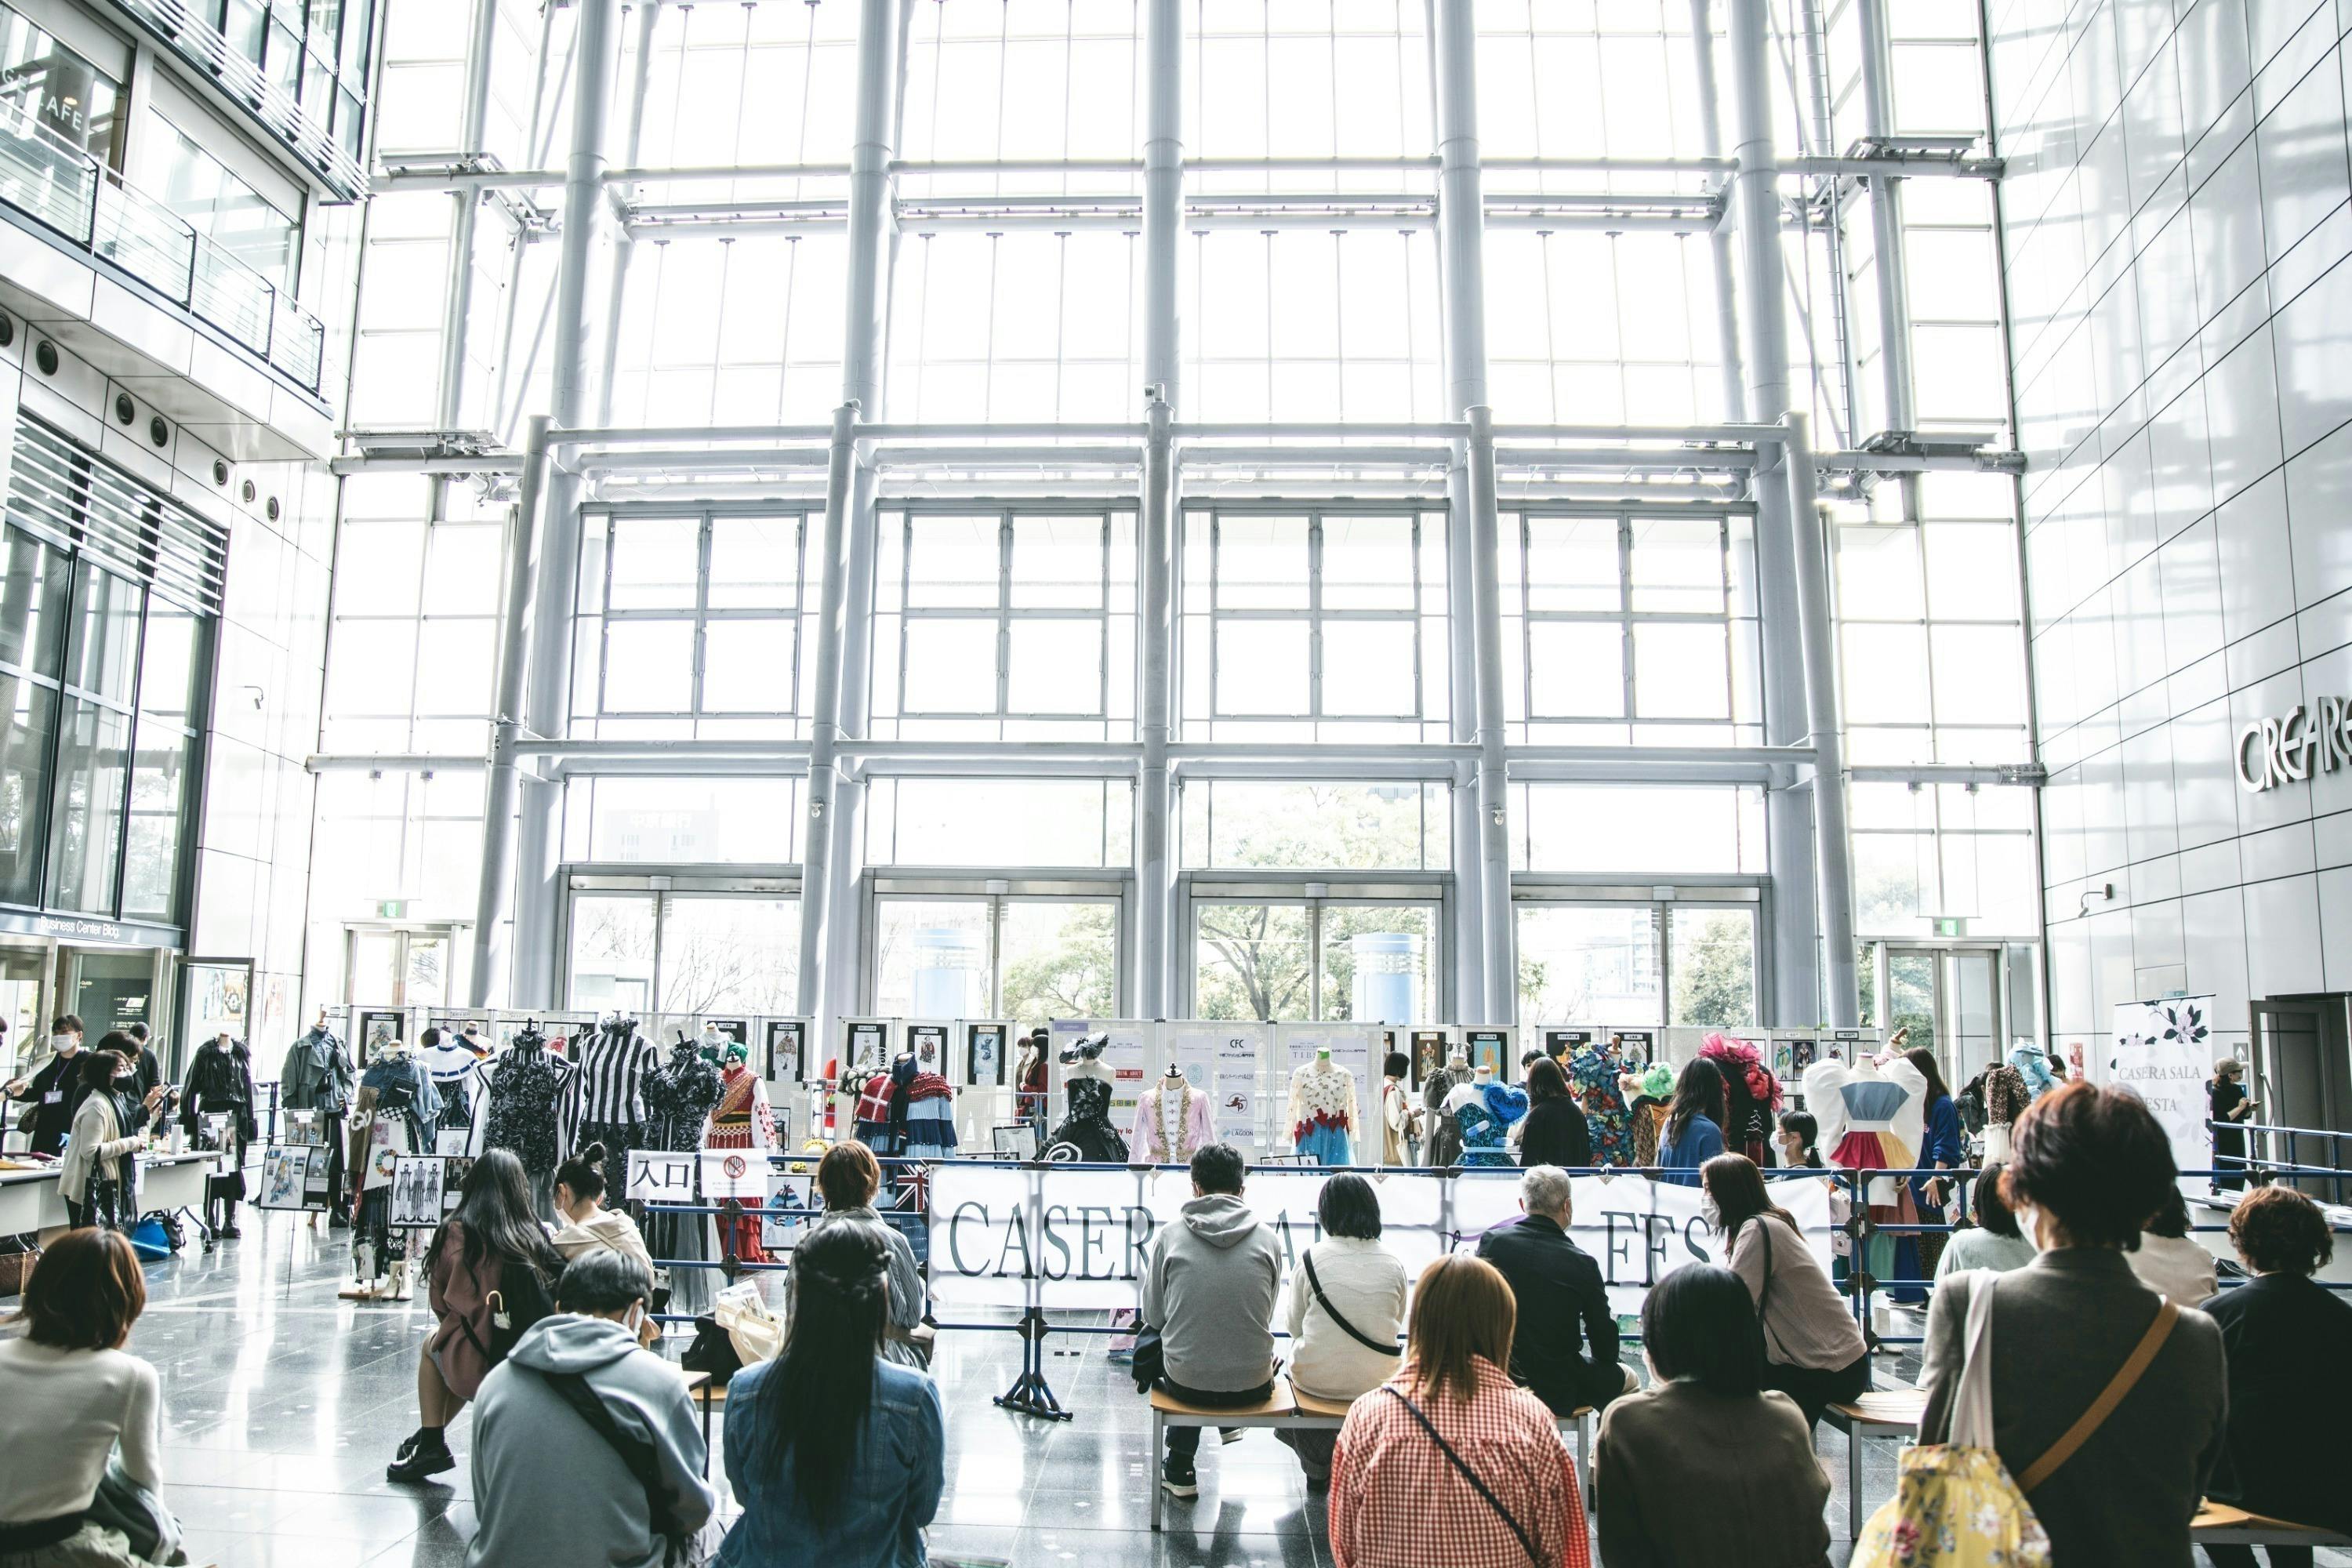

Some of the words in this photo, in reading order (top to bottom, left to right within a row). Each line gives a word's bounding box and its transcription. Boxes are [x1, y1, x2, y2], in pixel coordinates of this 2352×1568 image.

[40, 916, 74, 933] Business
[76, 920, 101, 935] Center
[103, 924, 119, 939] Bldg.
[1229, 1039, 1245, 1048] CFC
[2119, 1067, 2166, 1080] CASERA
[2170, 1065, 2201, 1080] SALA
[2145, 1098, 2177, 1112] ESTA
[631, 1160, 690, 1188] 入口
[949, 1201, 1155, 1281] CASER
[1600, 1210, 1711, 1287] FES
